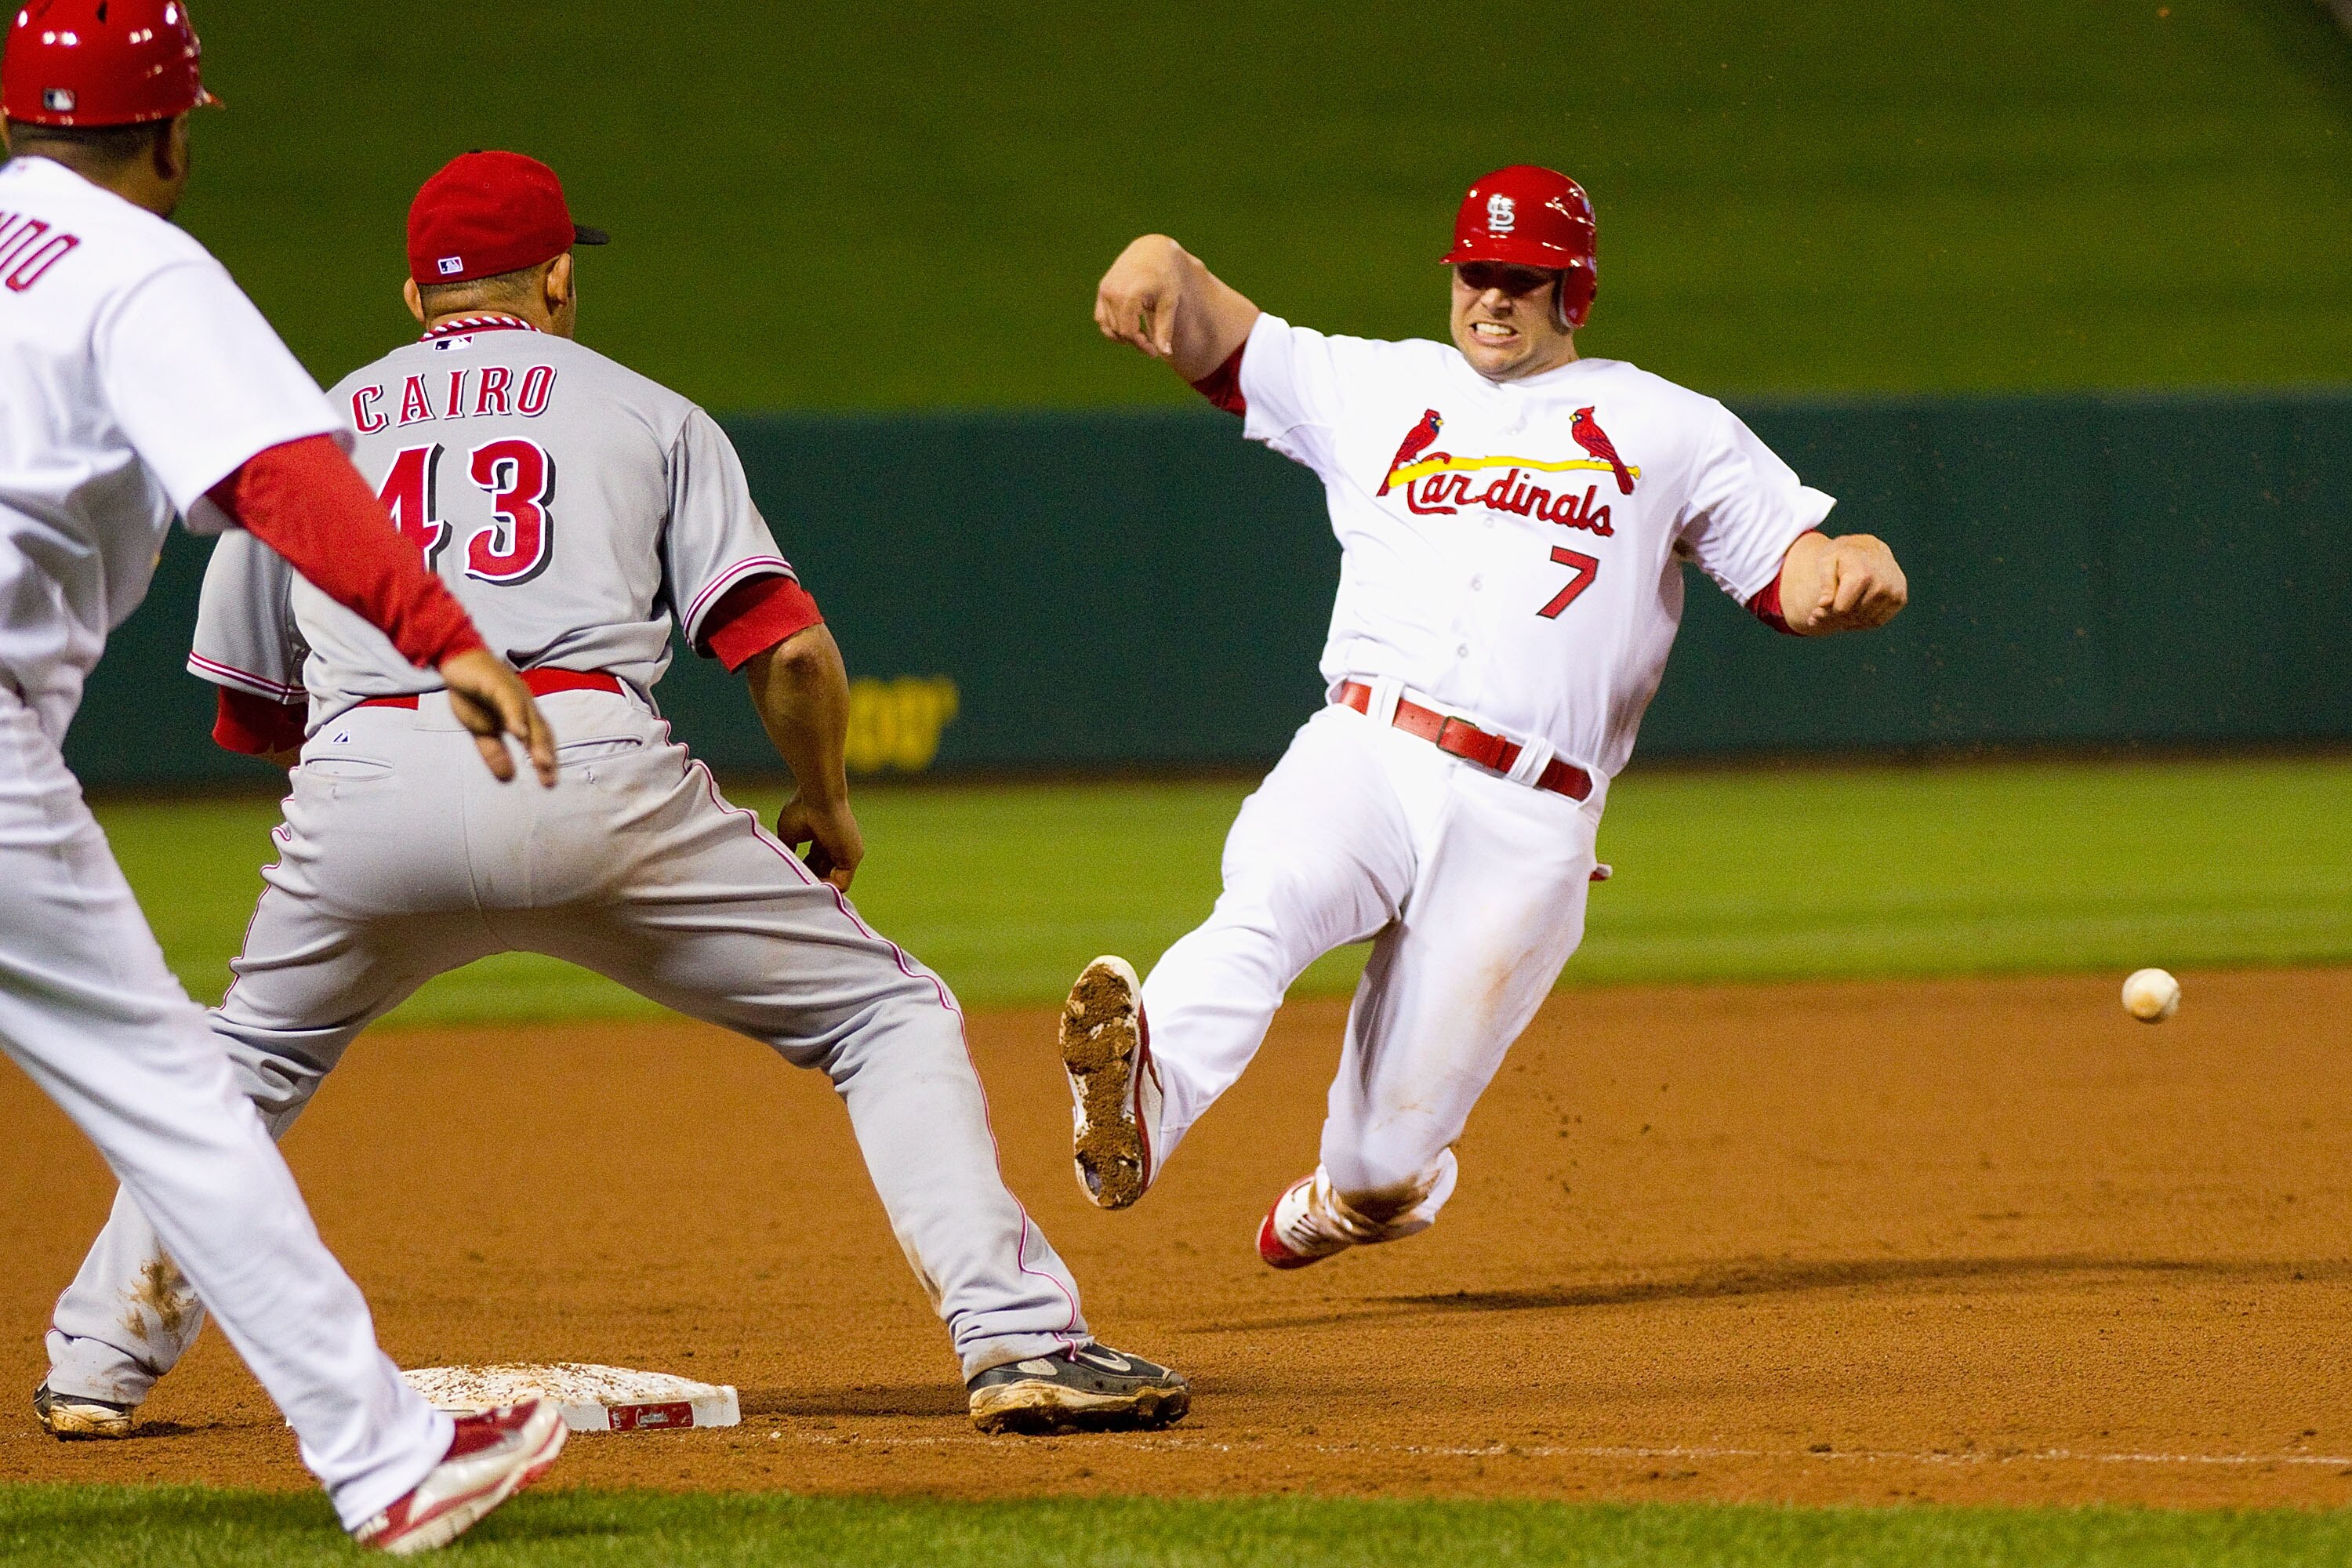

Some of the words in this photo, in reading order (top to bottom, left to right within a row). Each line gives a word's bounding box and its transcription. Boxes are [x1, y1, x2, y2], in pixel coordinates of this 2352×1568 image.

[0, 212, 81, 292] DO
[352, 365, 556, 435] CAIRO
[376, 436, 556, 586] 43
[1406, 452, 1614, 538] Cardinals
[1536, 546, 1599, 619] 7
